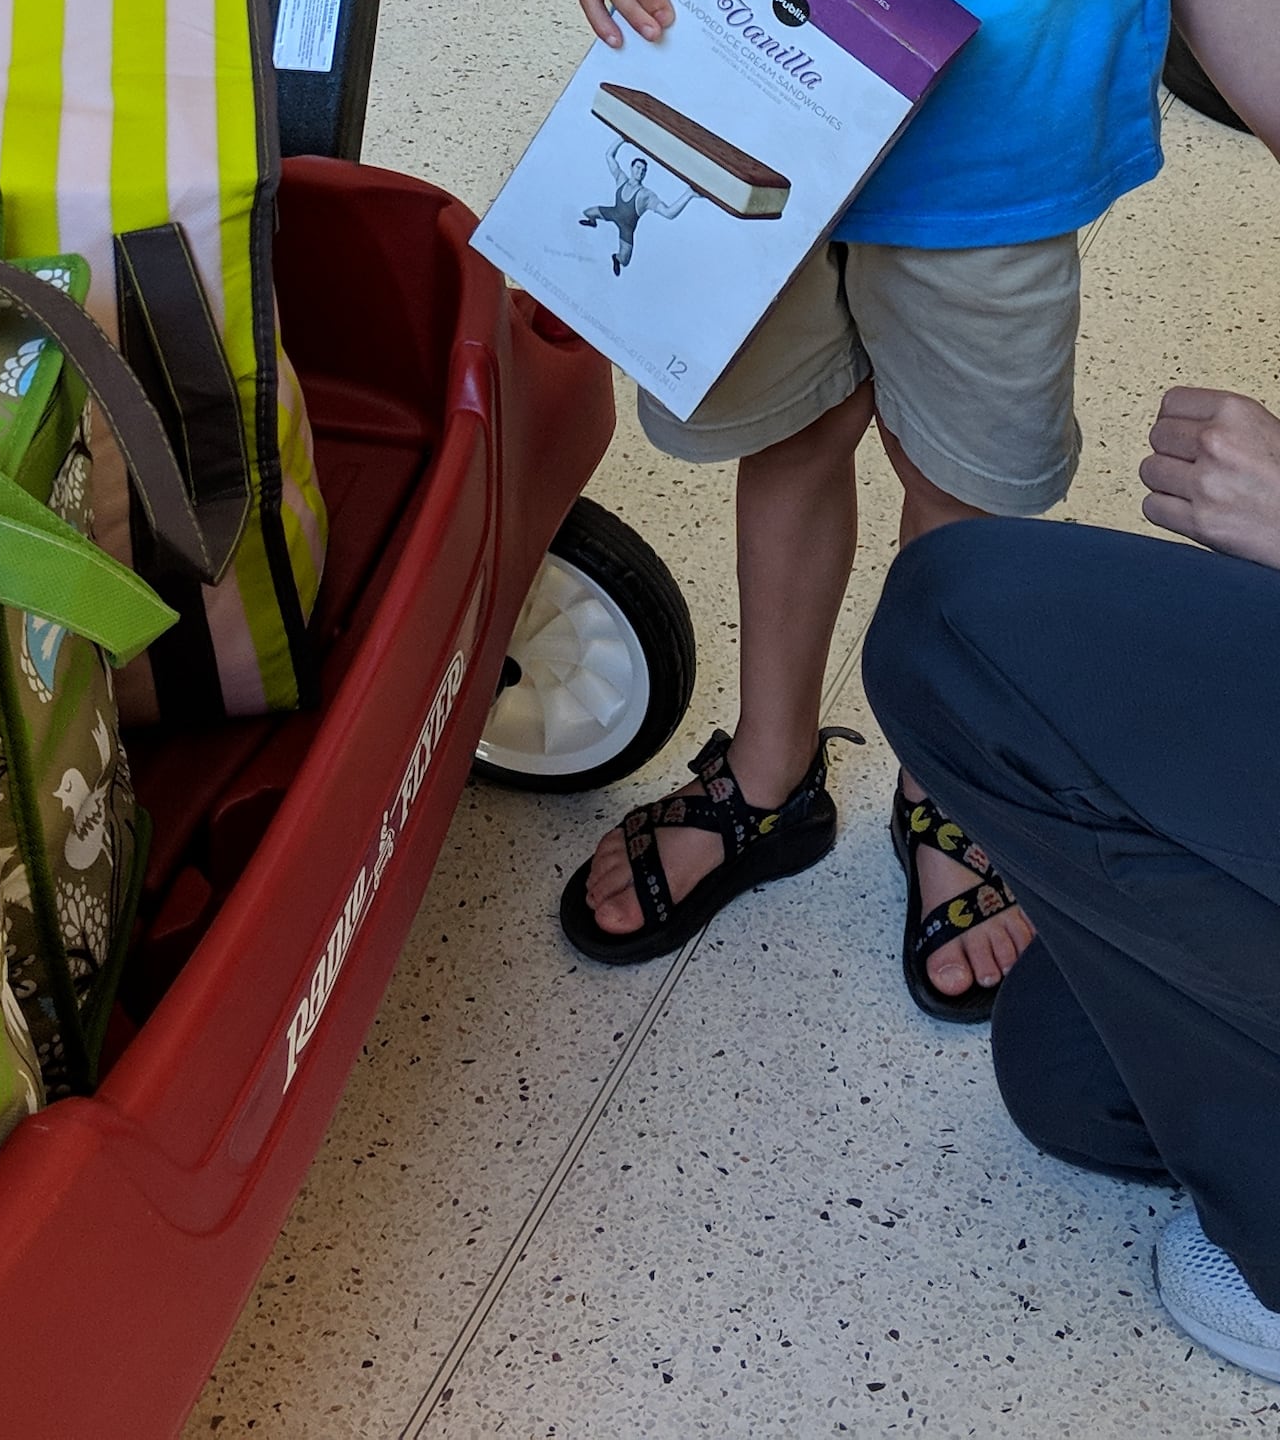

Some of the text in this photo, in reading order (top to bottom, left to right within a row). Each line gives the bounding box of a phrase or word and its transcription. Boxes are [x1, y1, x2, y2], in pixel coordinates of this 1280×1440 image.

[721, 31, 742, 50] ICE
[738, 45, 777, 79] CREAM
[777, 76, 843, 131] SANDWICHES
[664, 354, 689, 381] 12
[283, 650, 465, 1095] RADIO FLYER
